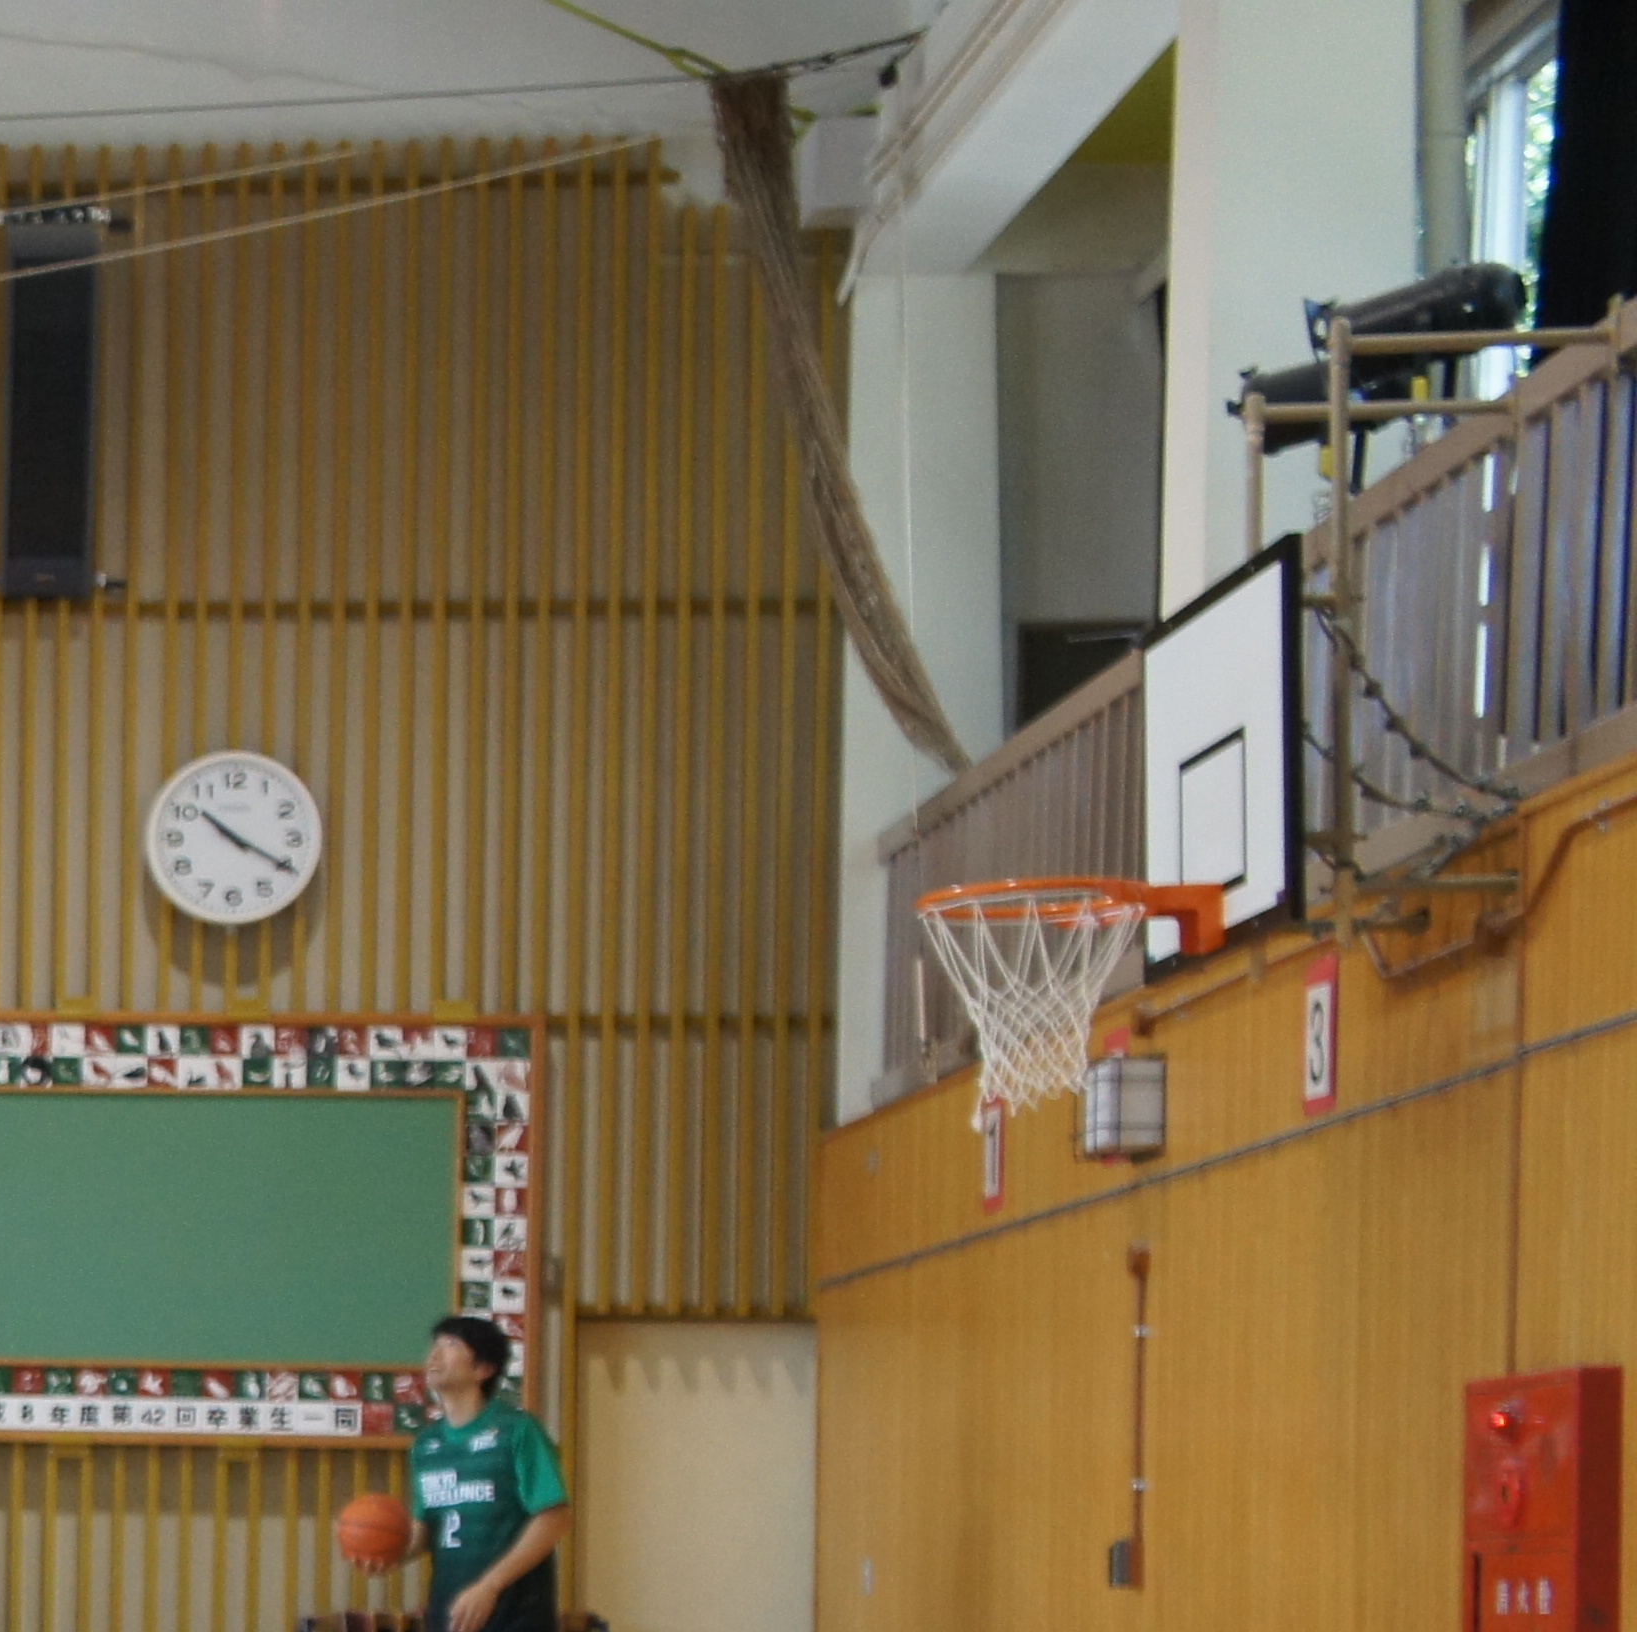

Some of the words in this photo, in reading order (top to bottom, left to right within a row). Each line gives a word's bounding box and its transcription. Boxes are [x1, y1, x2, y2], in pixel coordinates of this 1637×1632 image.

[226, 772, 247, 789] 12
[193, 784, 214, 799] 11
[175, 804, 199, 821] 10
[278, 801, 296, 819] 2
[166, 829, 185, 847] 9
[285, 830, 304, 848] 3
[175, 856, 193, 875] 8
[198, 880, 215, 898] 7
[256, 877, 274, 897] 5
[225, 887, 242, 906] 6
[1309, 1000, 1325, 1087] 3
